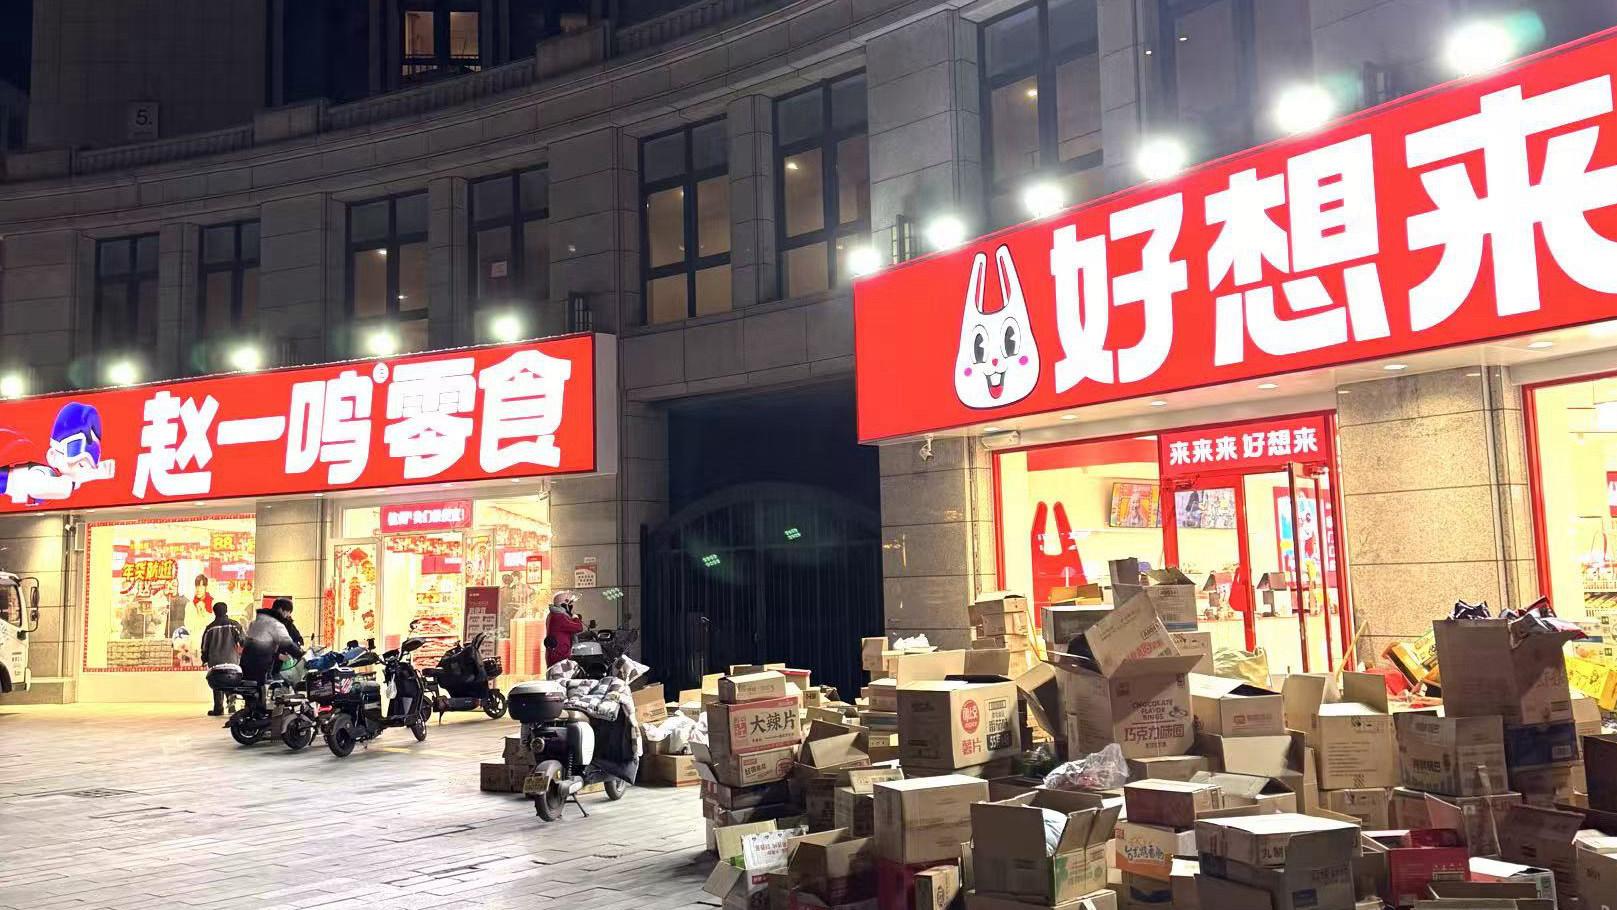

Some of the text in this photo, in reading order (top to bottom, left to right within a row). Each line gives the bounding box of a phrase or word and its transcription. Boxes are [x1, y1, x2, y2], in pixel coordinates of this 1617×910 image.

[1050, 75, 1617, 394] 好想来
[132, 349, 572, 499] 赵一鸣零食
[1169, 426, 1319, 466] 来来来 好想来
[749, 709, 797, 736] 大辣片
